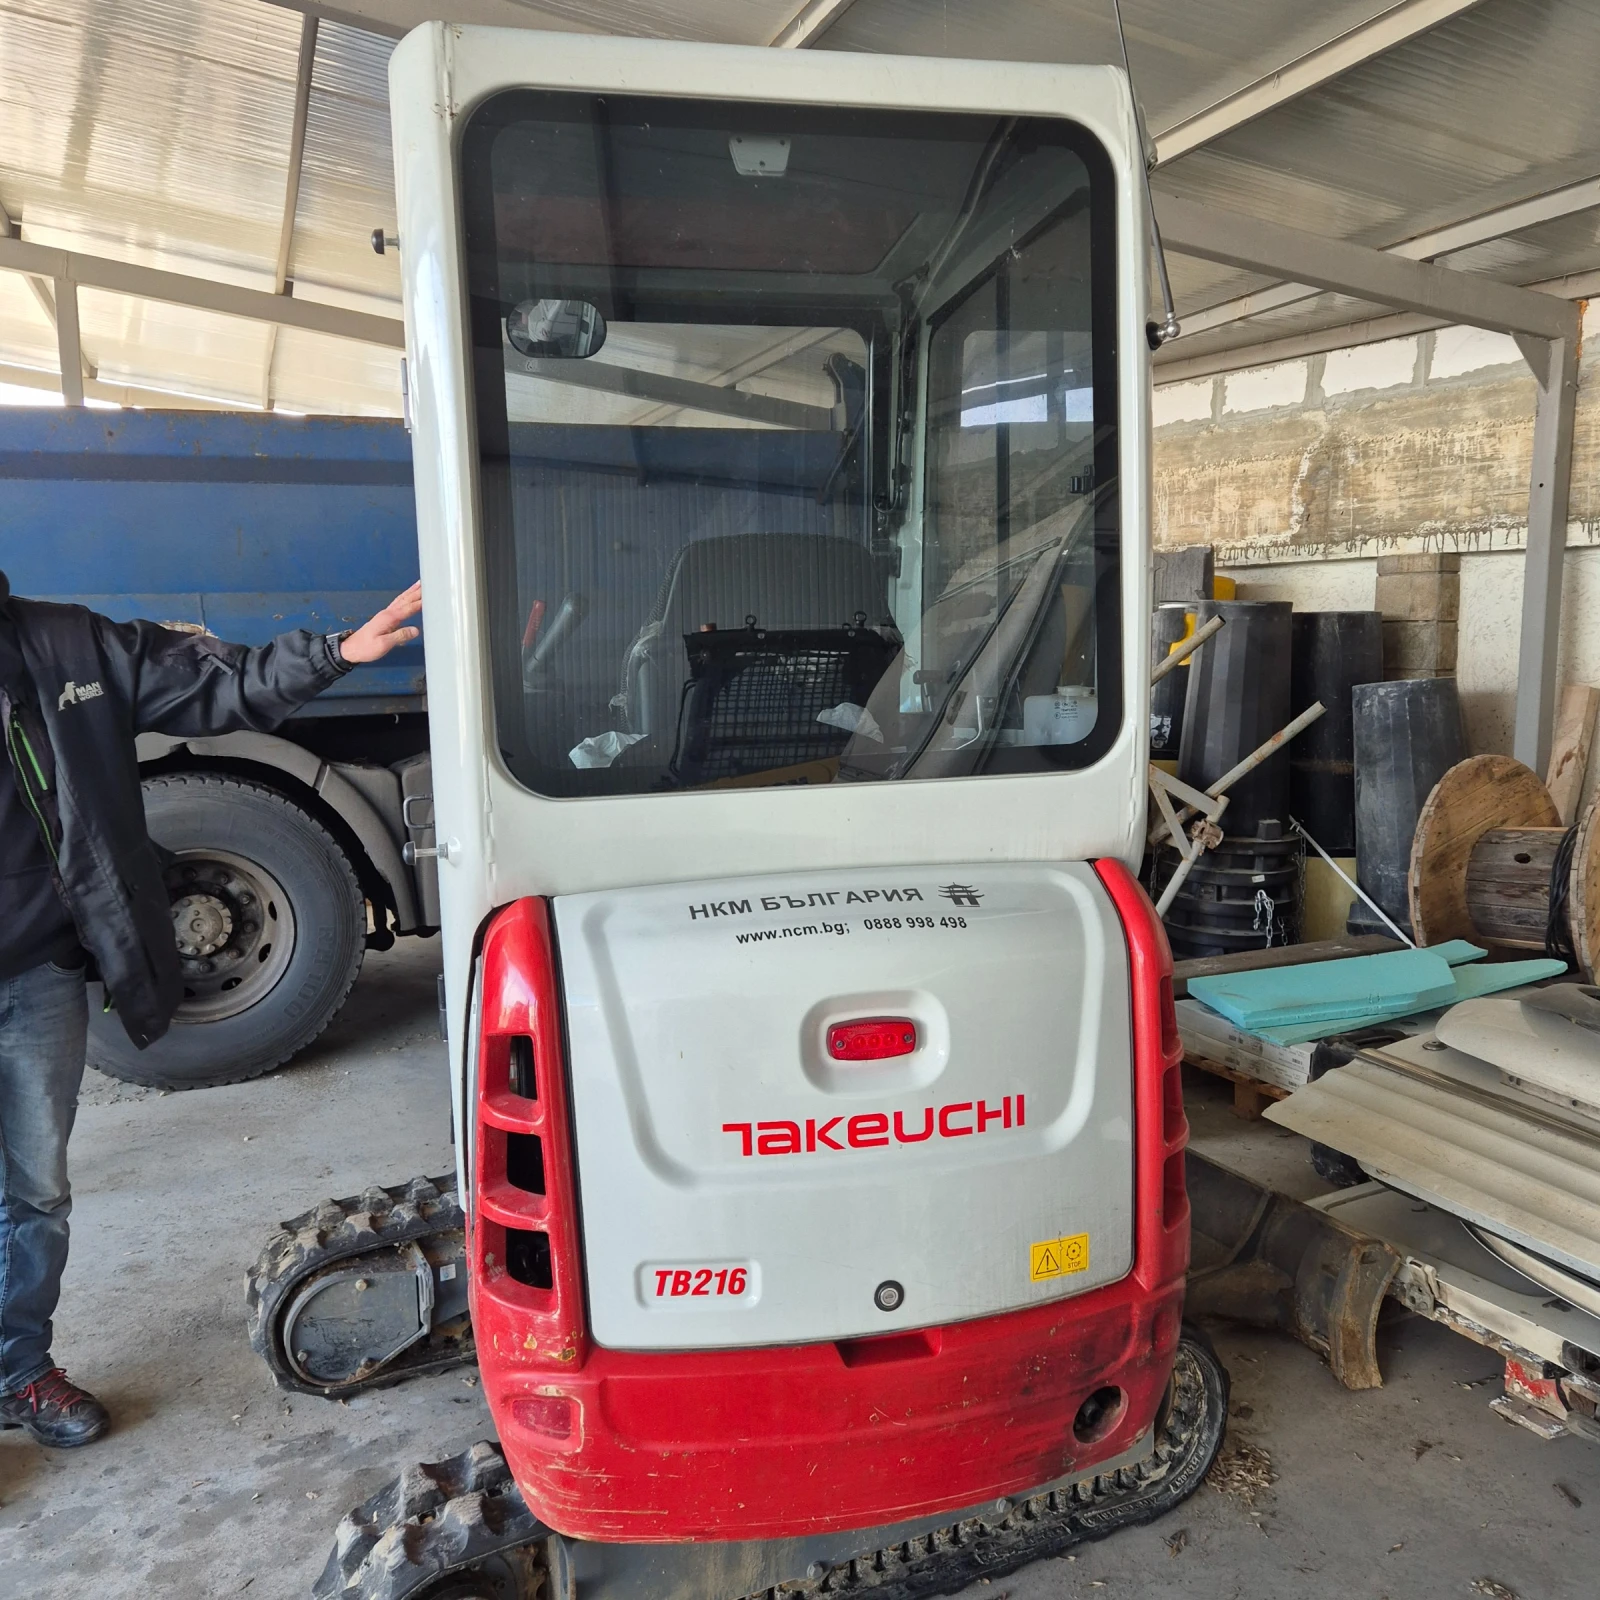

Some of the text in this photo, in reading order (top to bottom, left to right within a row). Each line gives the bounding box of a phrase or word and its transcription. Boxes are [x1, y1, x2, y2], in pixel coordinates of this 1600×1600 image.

[75, 681, 101, 696] MAN
[688, 887, 924, 920] НКМ БЪЛГАРИЯ
[863, 917, 902, 931] 0888
[905, 916, 935, 930] 998
[939, 915, 968, 929] 498
[1067, 1260, 1082, 1270] STOP
[654, 1267, 748, 1298] TB216
